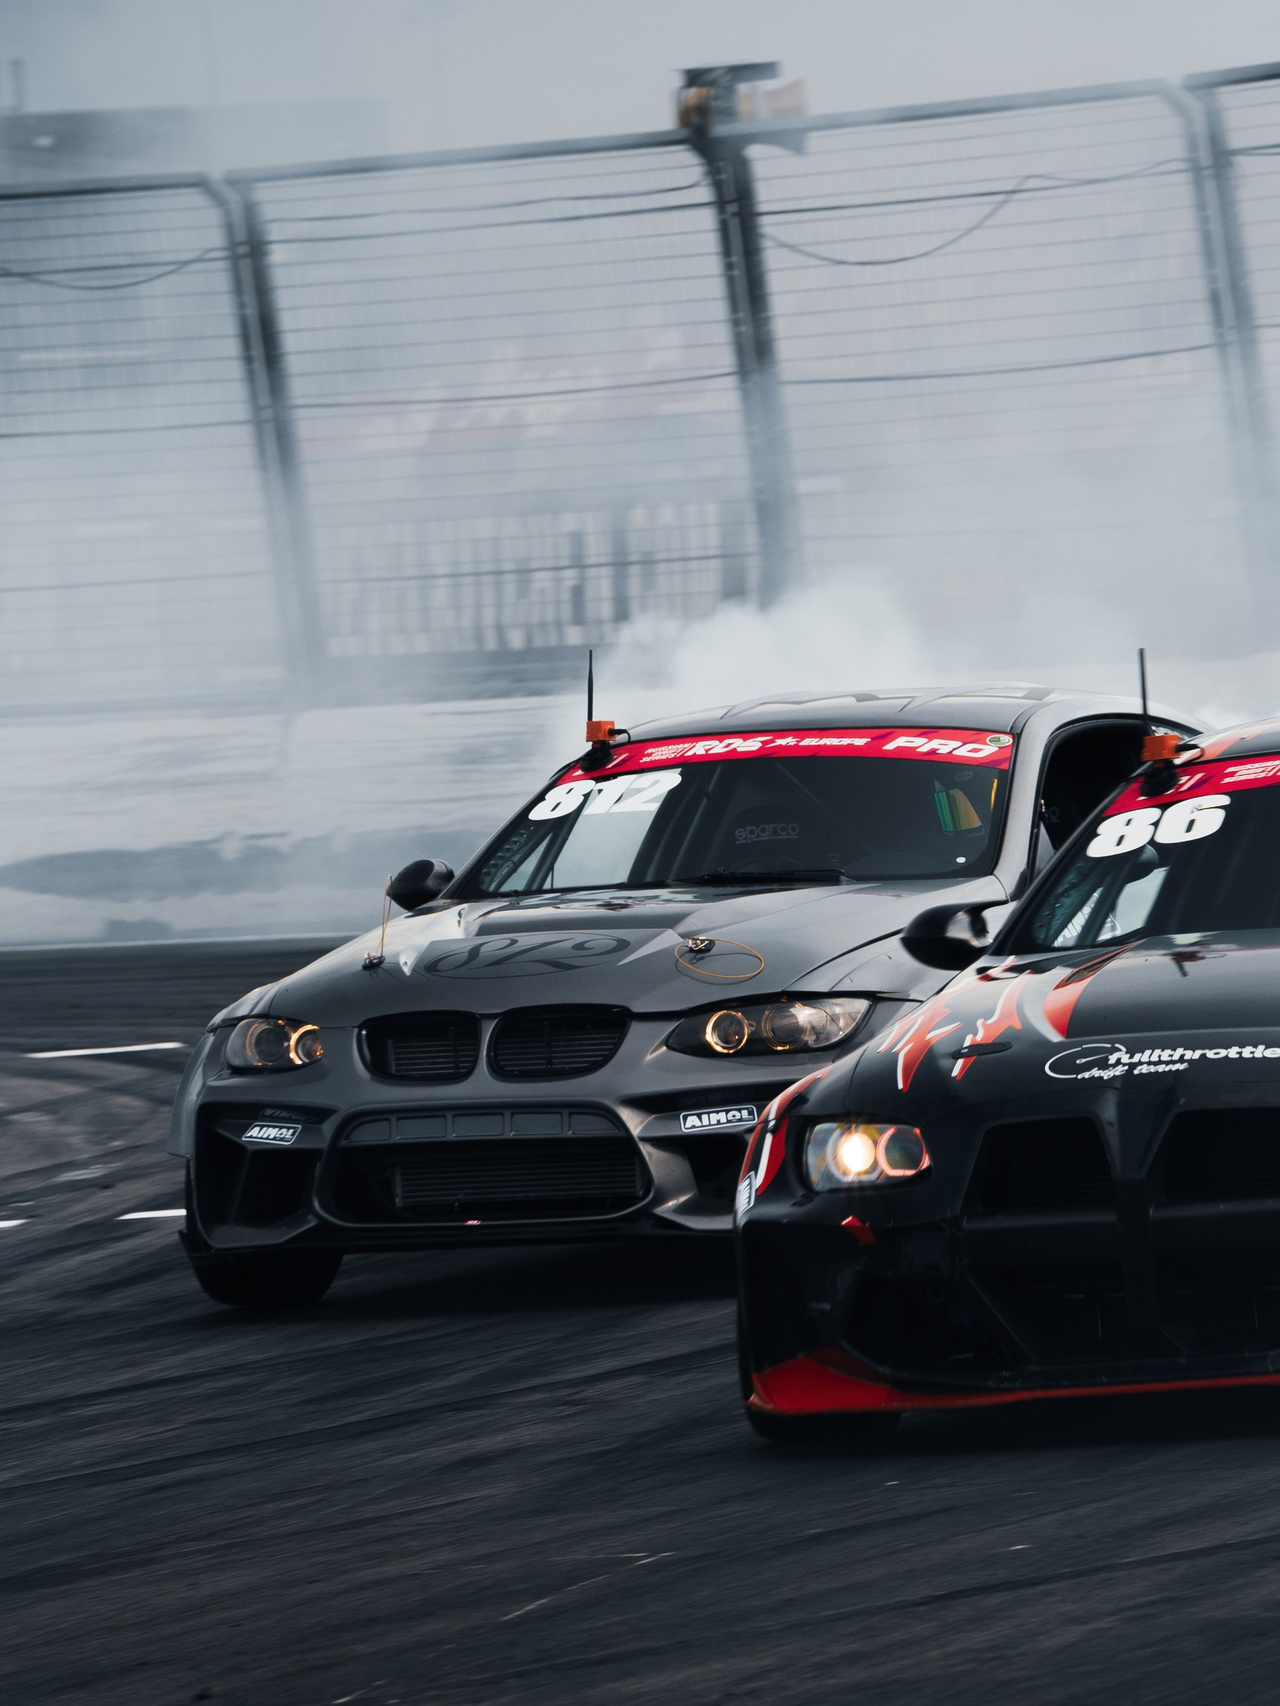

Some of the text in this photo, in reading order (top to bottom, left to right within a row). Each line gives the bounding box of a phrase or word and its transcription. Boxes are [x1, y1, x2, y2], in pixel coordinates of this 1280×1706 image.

[684, 736, 774, 757] RDS
[798, 737, 871, 746] EUROPE
[882, 735, 999, 758] PRO
[527, 772, 683, 821] 812
[735, 823, 799, 844] sparco
[1085, 793, 1232, 858] 86
[1077, 1062, 1190, 1080] drift team
[684, 1109, 754, 1129] AIMOL
[245, 1126, 295, 1140] AIMOL
